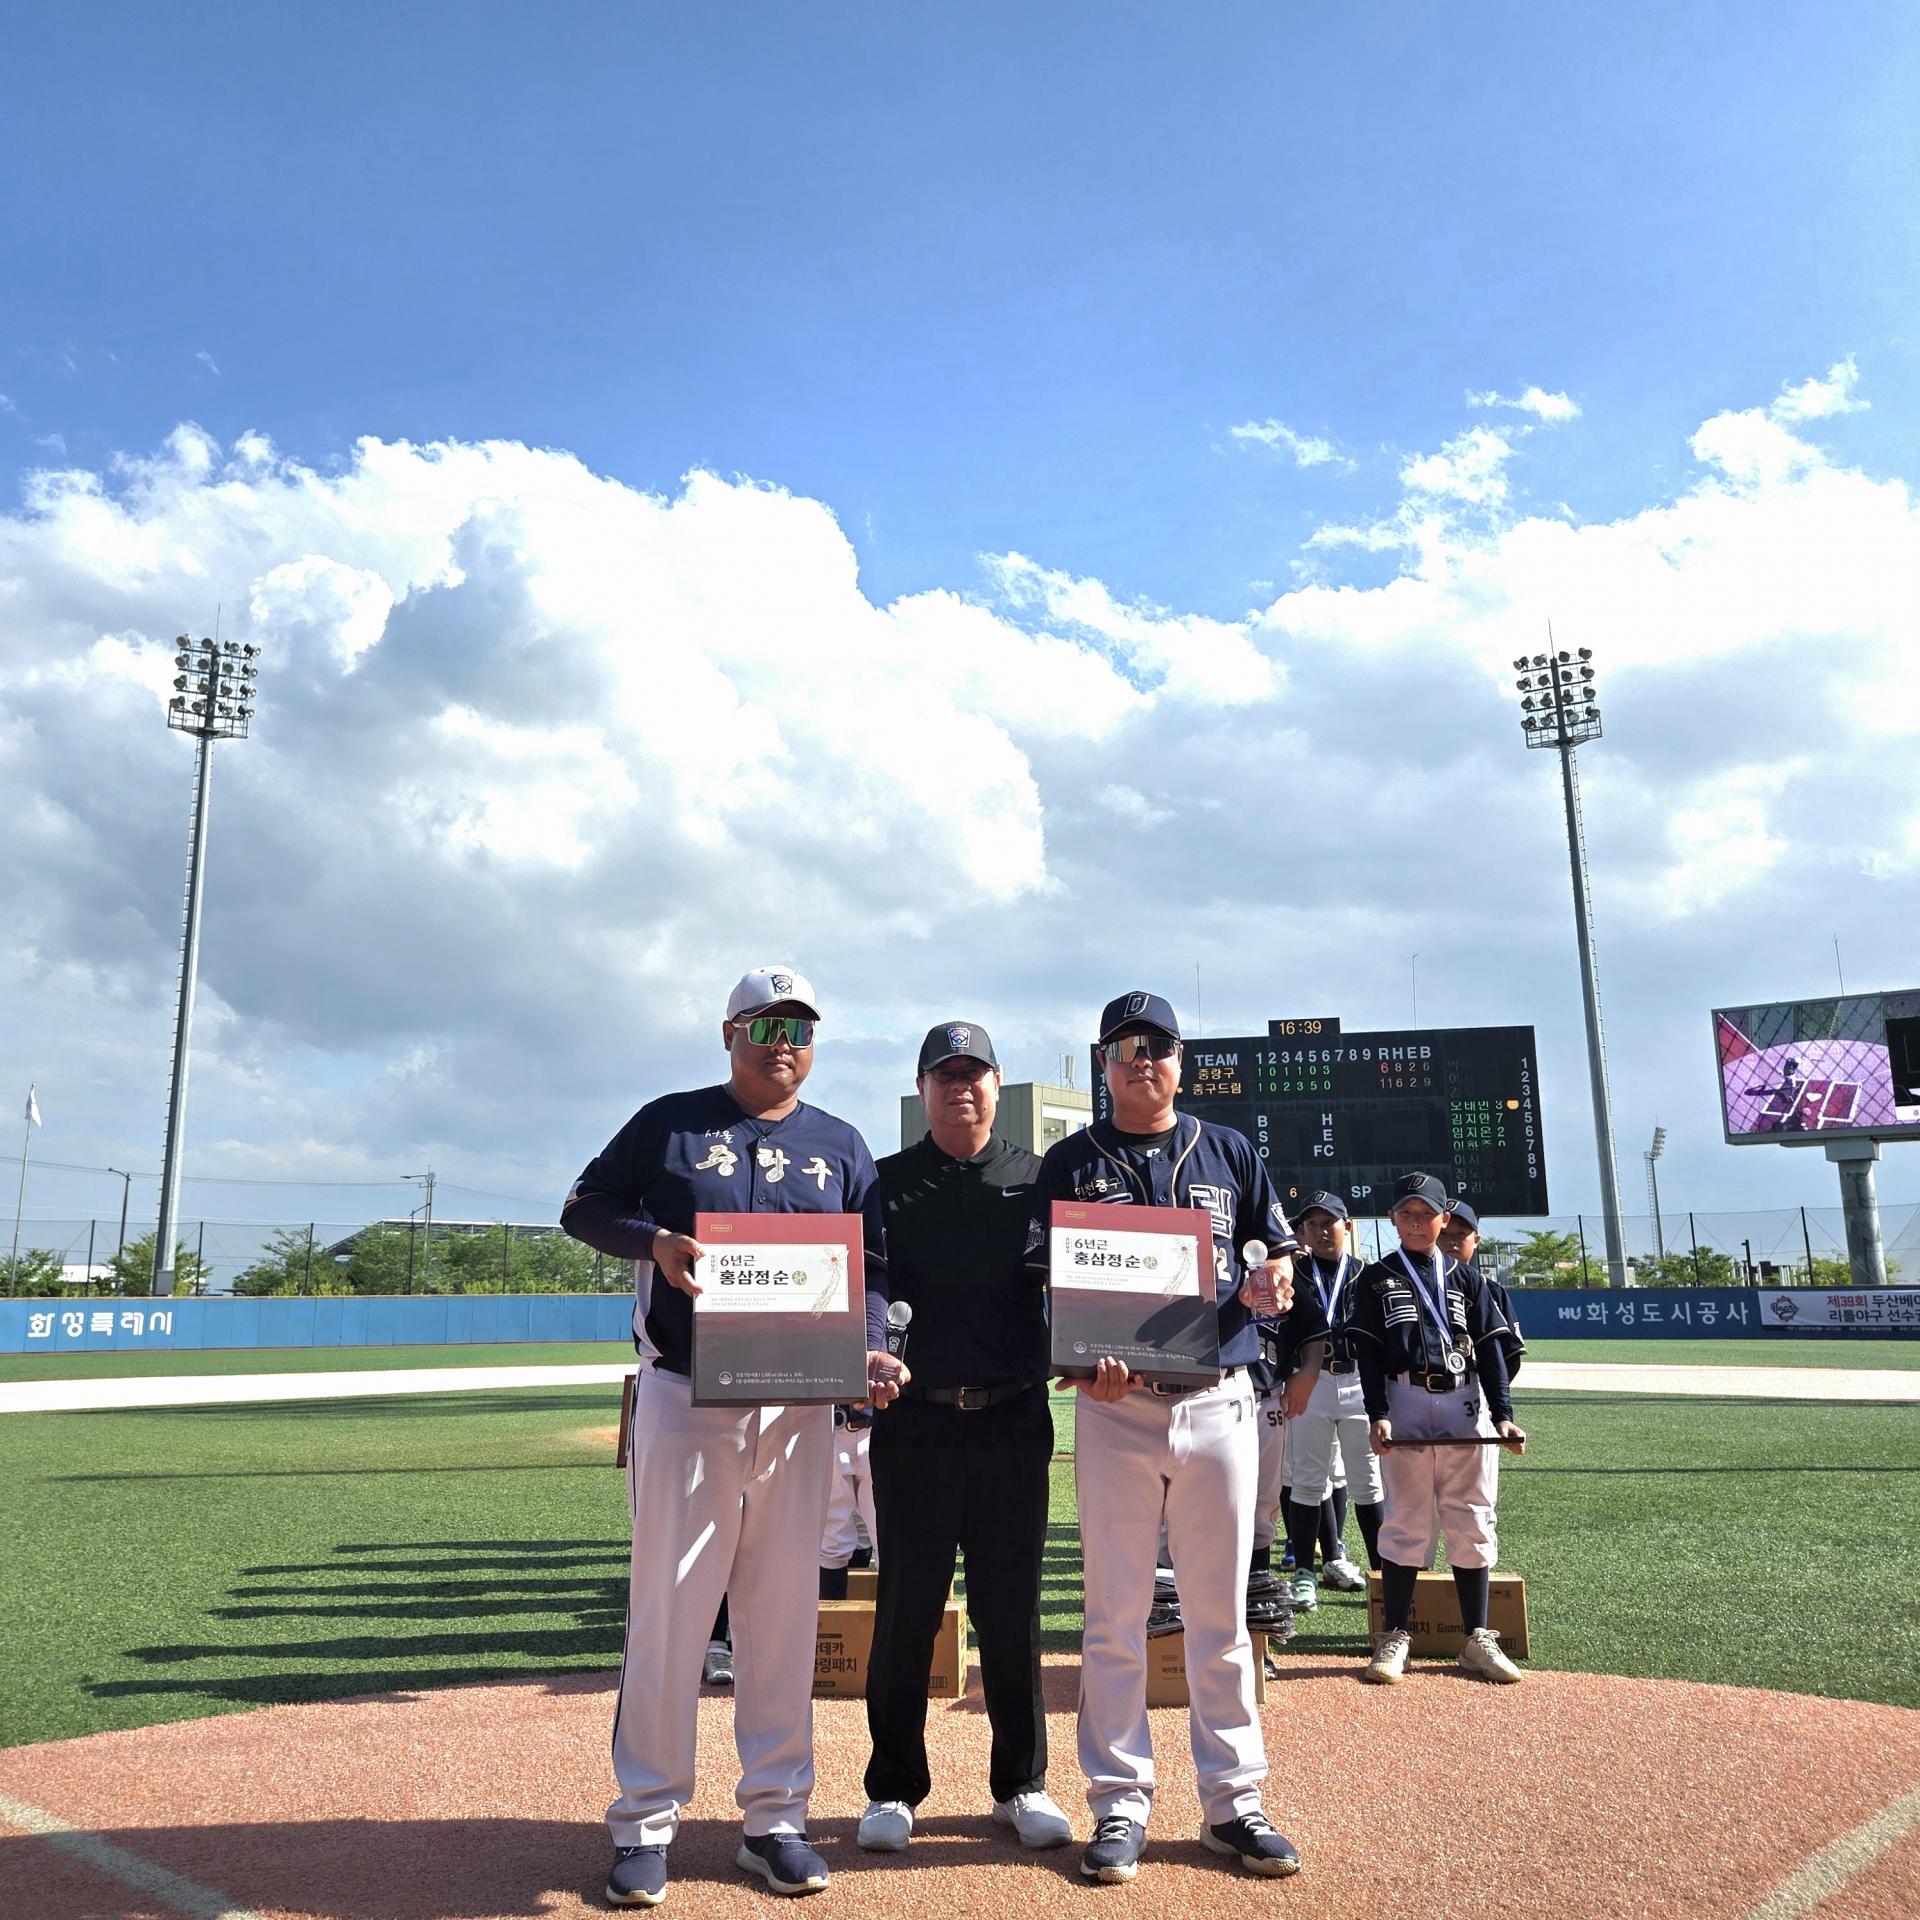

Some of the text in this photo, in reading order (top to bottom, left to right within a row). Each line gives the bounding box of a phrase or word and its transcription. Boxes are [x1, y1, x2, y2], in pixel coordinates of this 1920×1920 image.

[1279, 1020, 1322, 1035] 16:39
[1194, 1053, 1238, 1066] TEAM
[1255, 1052, 1262, 1064] 1
[1268, 1052, 1277, 1064] 2
[1281, 1051, 1290, 1063] 3
[1295, 1051, 1303, 1063] 4
[1308, 1050, 1317, 1062] 5
[1321, 1050, 1330, 1062] 6
[1335, 1050, 1344, 1062] 7
[1348, 1049, 1357, 1061] 8
[1362, 1048, 1371, 1060] 9
[1521, 1057, 1528, 1069] 1
[1198, 1067, 1235, 1080] 중랑구
[1269, 1067, 1276, 1077] 0
[1309, 1066, 1316, 1076] 0
[1323, 1065, 1330, 1075] 3
[1380, 1062, 1389, 1074] 6
[1521, 1071, 1529, 1082] 2
[1099, 1085, 1106, 1097] 2
[1193, 1082, 1241, 1096] 중구드림
[1270, 1082, 1277, 1092] 0
[1284, 1082, 1291, 1092] 2
[1297, 1081, 1304, 1091] 3
[1310, 1081, 1317, 1091] 5
[1324, 1081, 1331, 1091] 0
[1522, 1085, 1530, 1096] 3
[1100, 1098, 1107, 1109] 3
[1523, 1099, 1531, 1110] 4
[1257, 1115, 1268, 1128] B
[1322, 1113, 1333, 1126] H
[1495, 1112, 1503, 1123] 7
[1524, 1112, 1533, 1123] 5
[704, 1129, 735, 1144] 서울
[1258, 1131, 1269, 1143] S
[1323, 1129, 1333, 1141] E
[1497, 1126, 1505, 1137] 2
[1525, 1125, 1534, 1137] 6
[1526, 1139, 1535, 1150] 7
[1313, 1145, 1334, 1157] FC
[1528, 1153, 1536, 1165] 8
[695, 1144, 833, 1191] 중랑구
[1529, 1167, 1538, 1178] 9
[1074, 1177, 1122, 1200] 인천중구
[1289, 1187, 1298, 1198] 6
[1351, 1185, 1371, 1198] SP
[1457, 1182, 1467, 1193] P
[1074, 1238, 1108, 1251] 6년근
[719, 1254, 756, 1267] 6년근
[1826, 1294, 1869, 1309] 제39회
[1586, 1302, 1749, 1326] 화성도시공사
